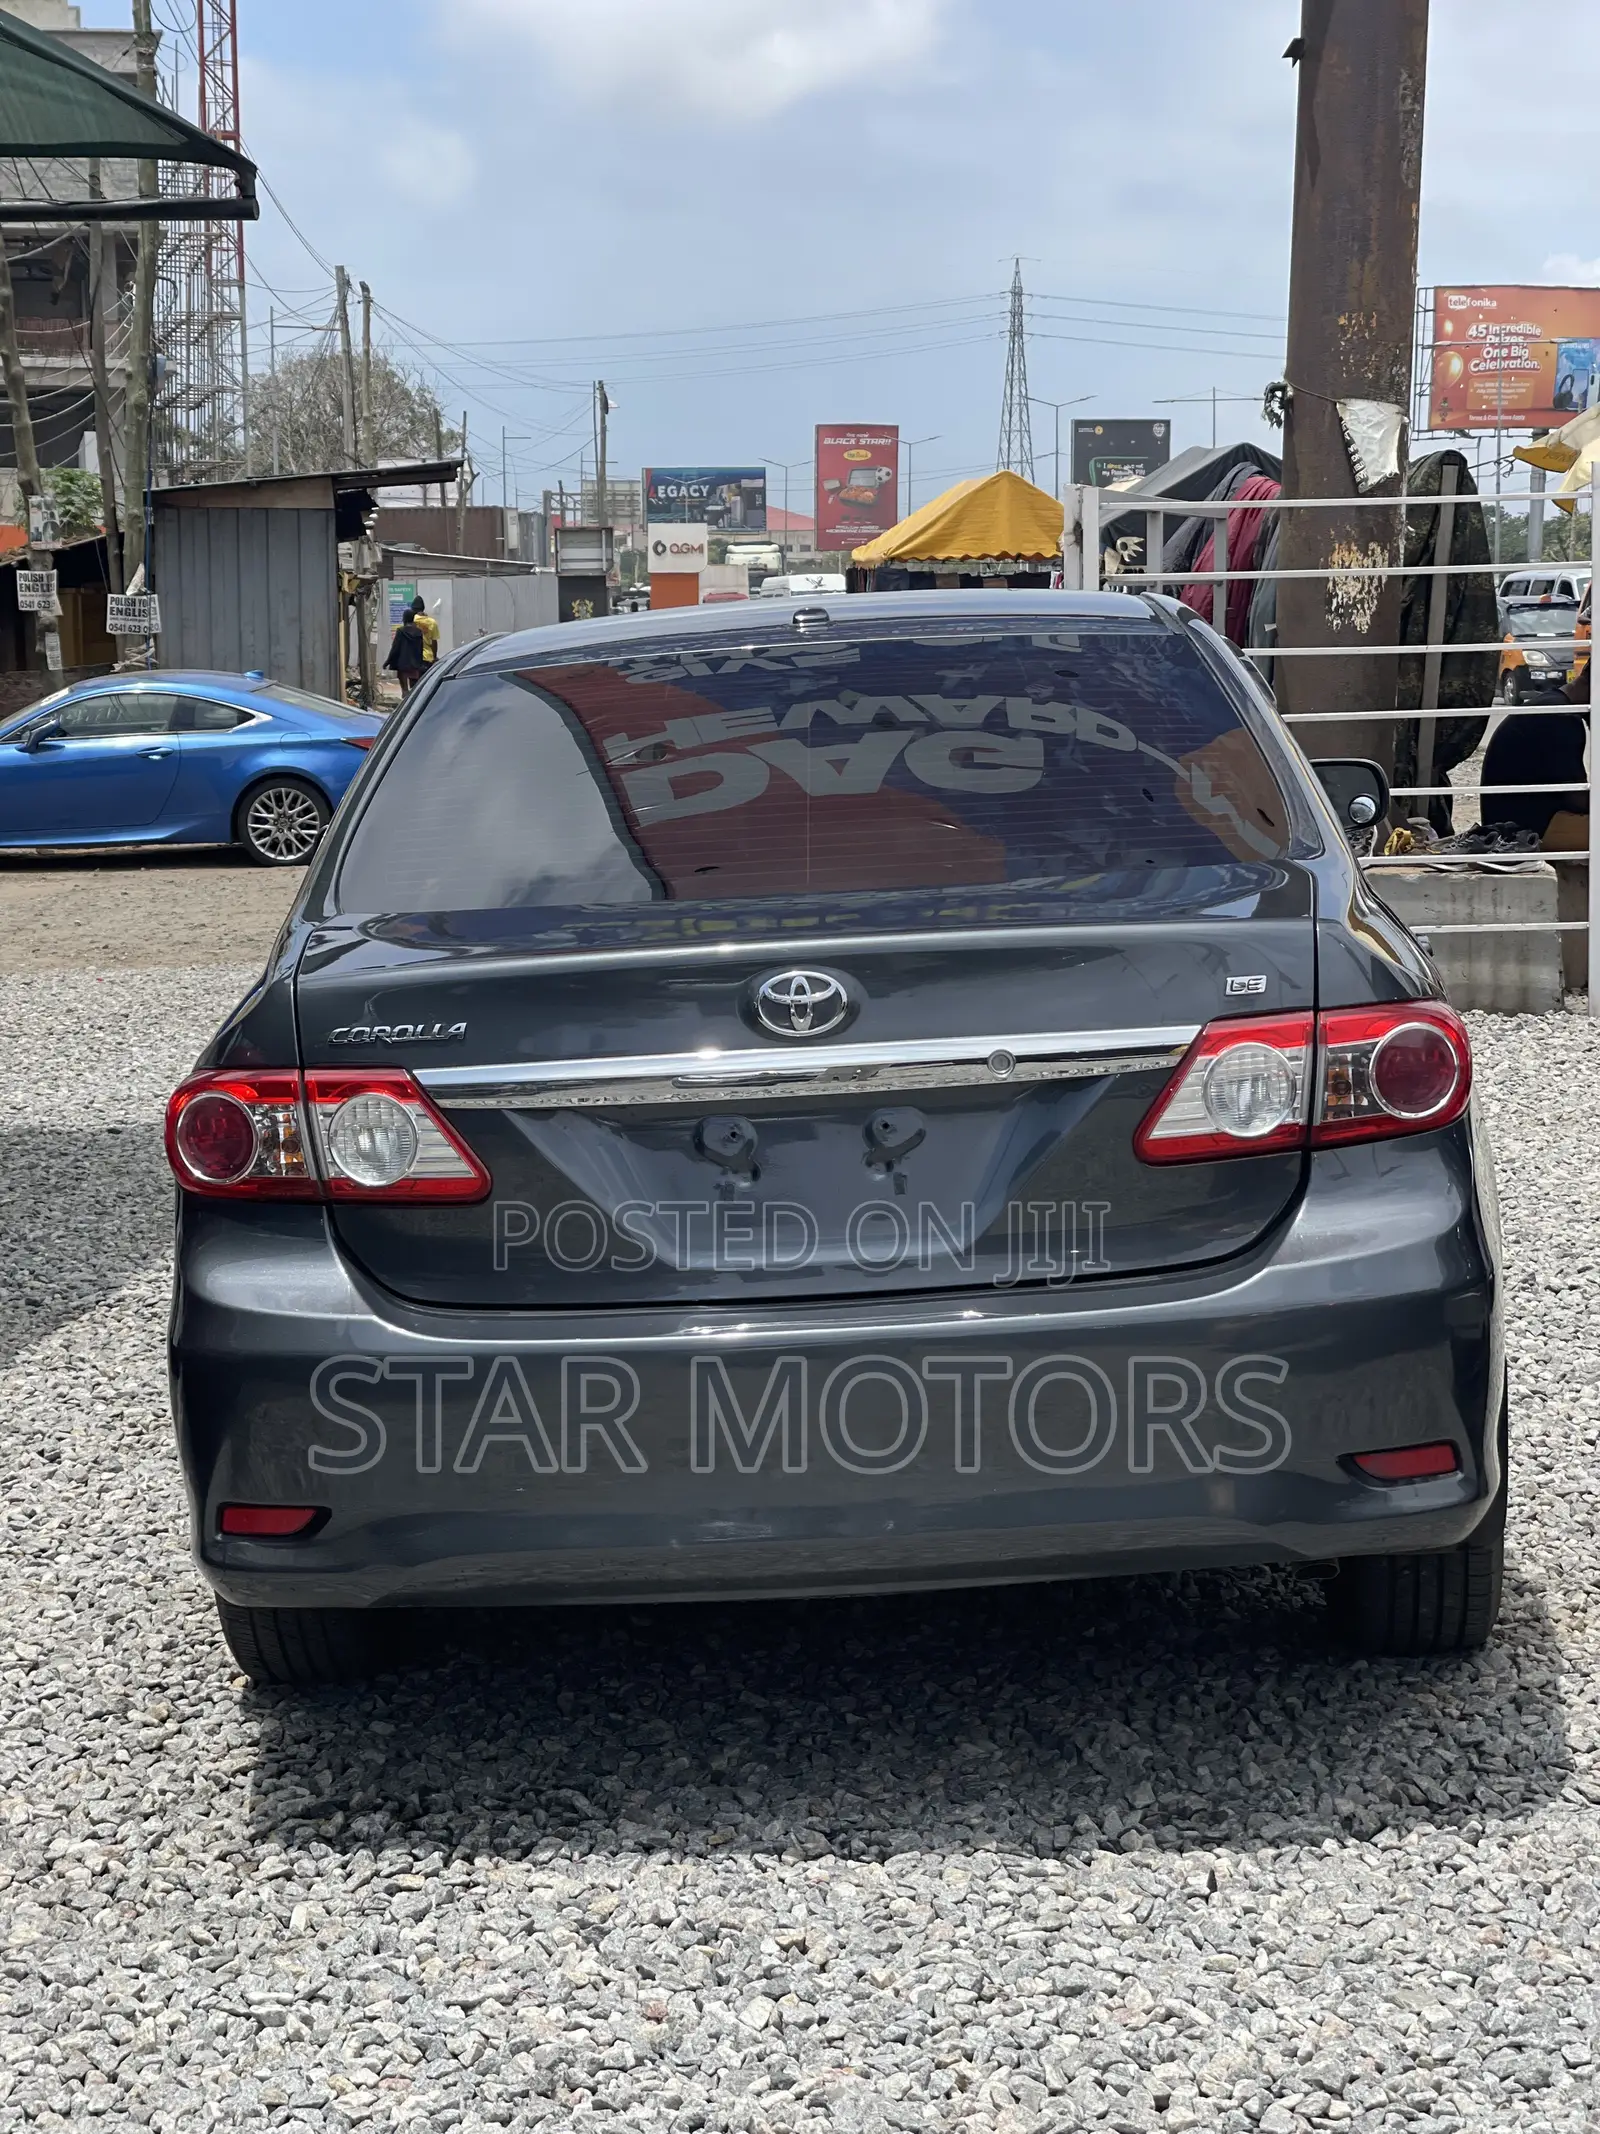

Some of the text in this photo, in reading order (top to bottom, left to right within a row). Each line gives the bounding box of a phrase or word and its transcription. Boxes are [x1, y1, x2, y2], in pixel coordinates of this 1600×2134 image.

[1449, 296, 1498, 308] telefonika
[1467, 323, 1542, 337] 45 Incredible
[1482, 345, 1529, 359] One Big
[823, 437, 857, 445] BLACK
[18, 572, 44, 583] POLISH
[20, 599, 35, 609] 0541
[37, 600, 51, 609] 623
[110, 596, 137, 608] POLISH
[108, 622, 126, 632] 0541
[127, 624, 142, 633] 623
[1225, 975, 1268, 996] LE
[328, 1022, 468, 1045] COROLLA
